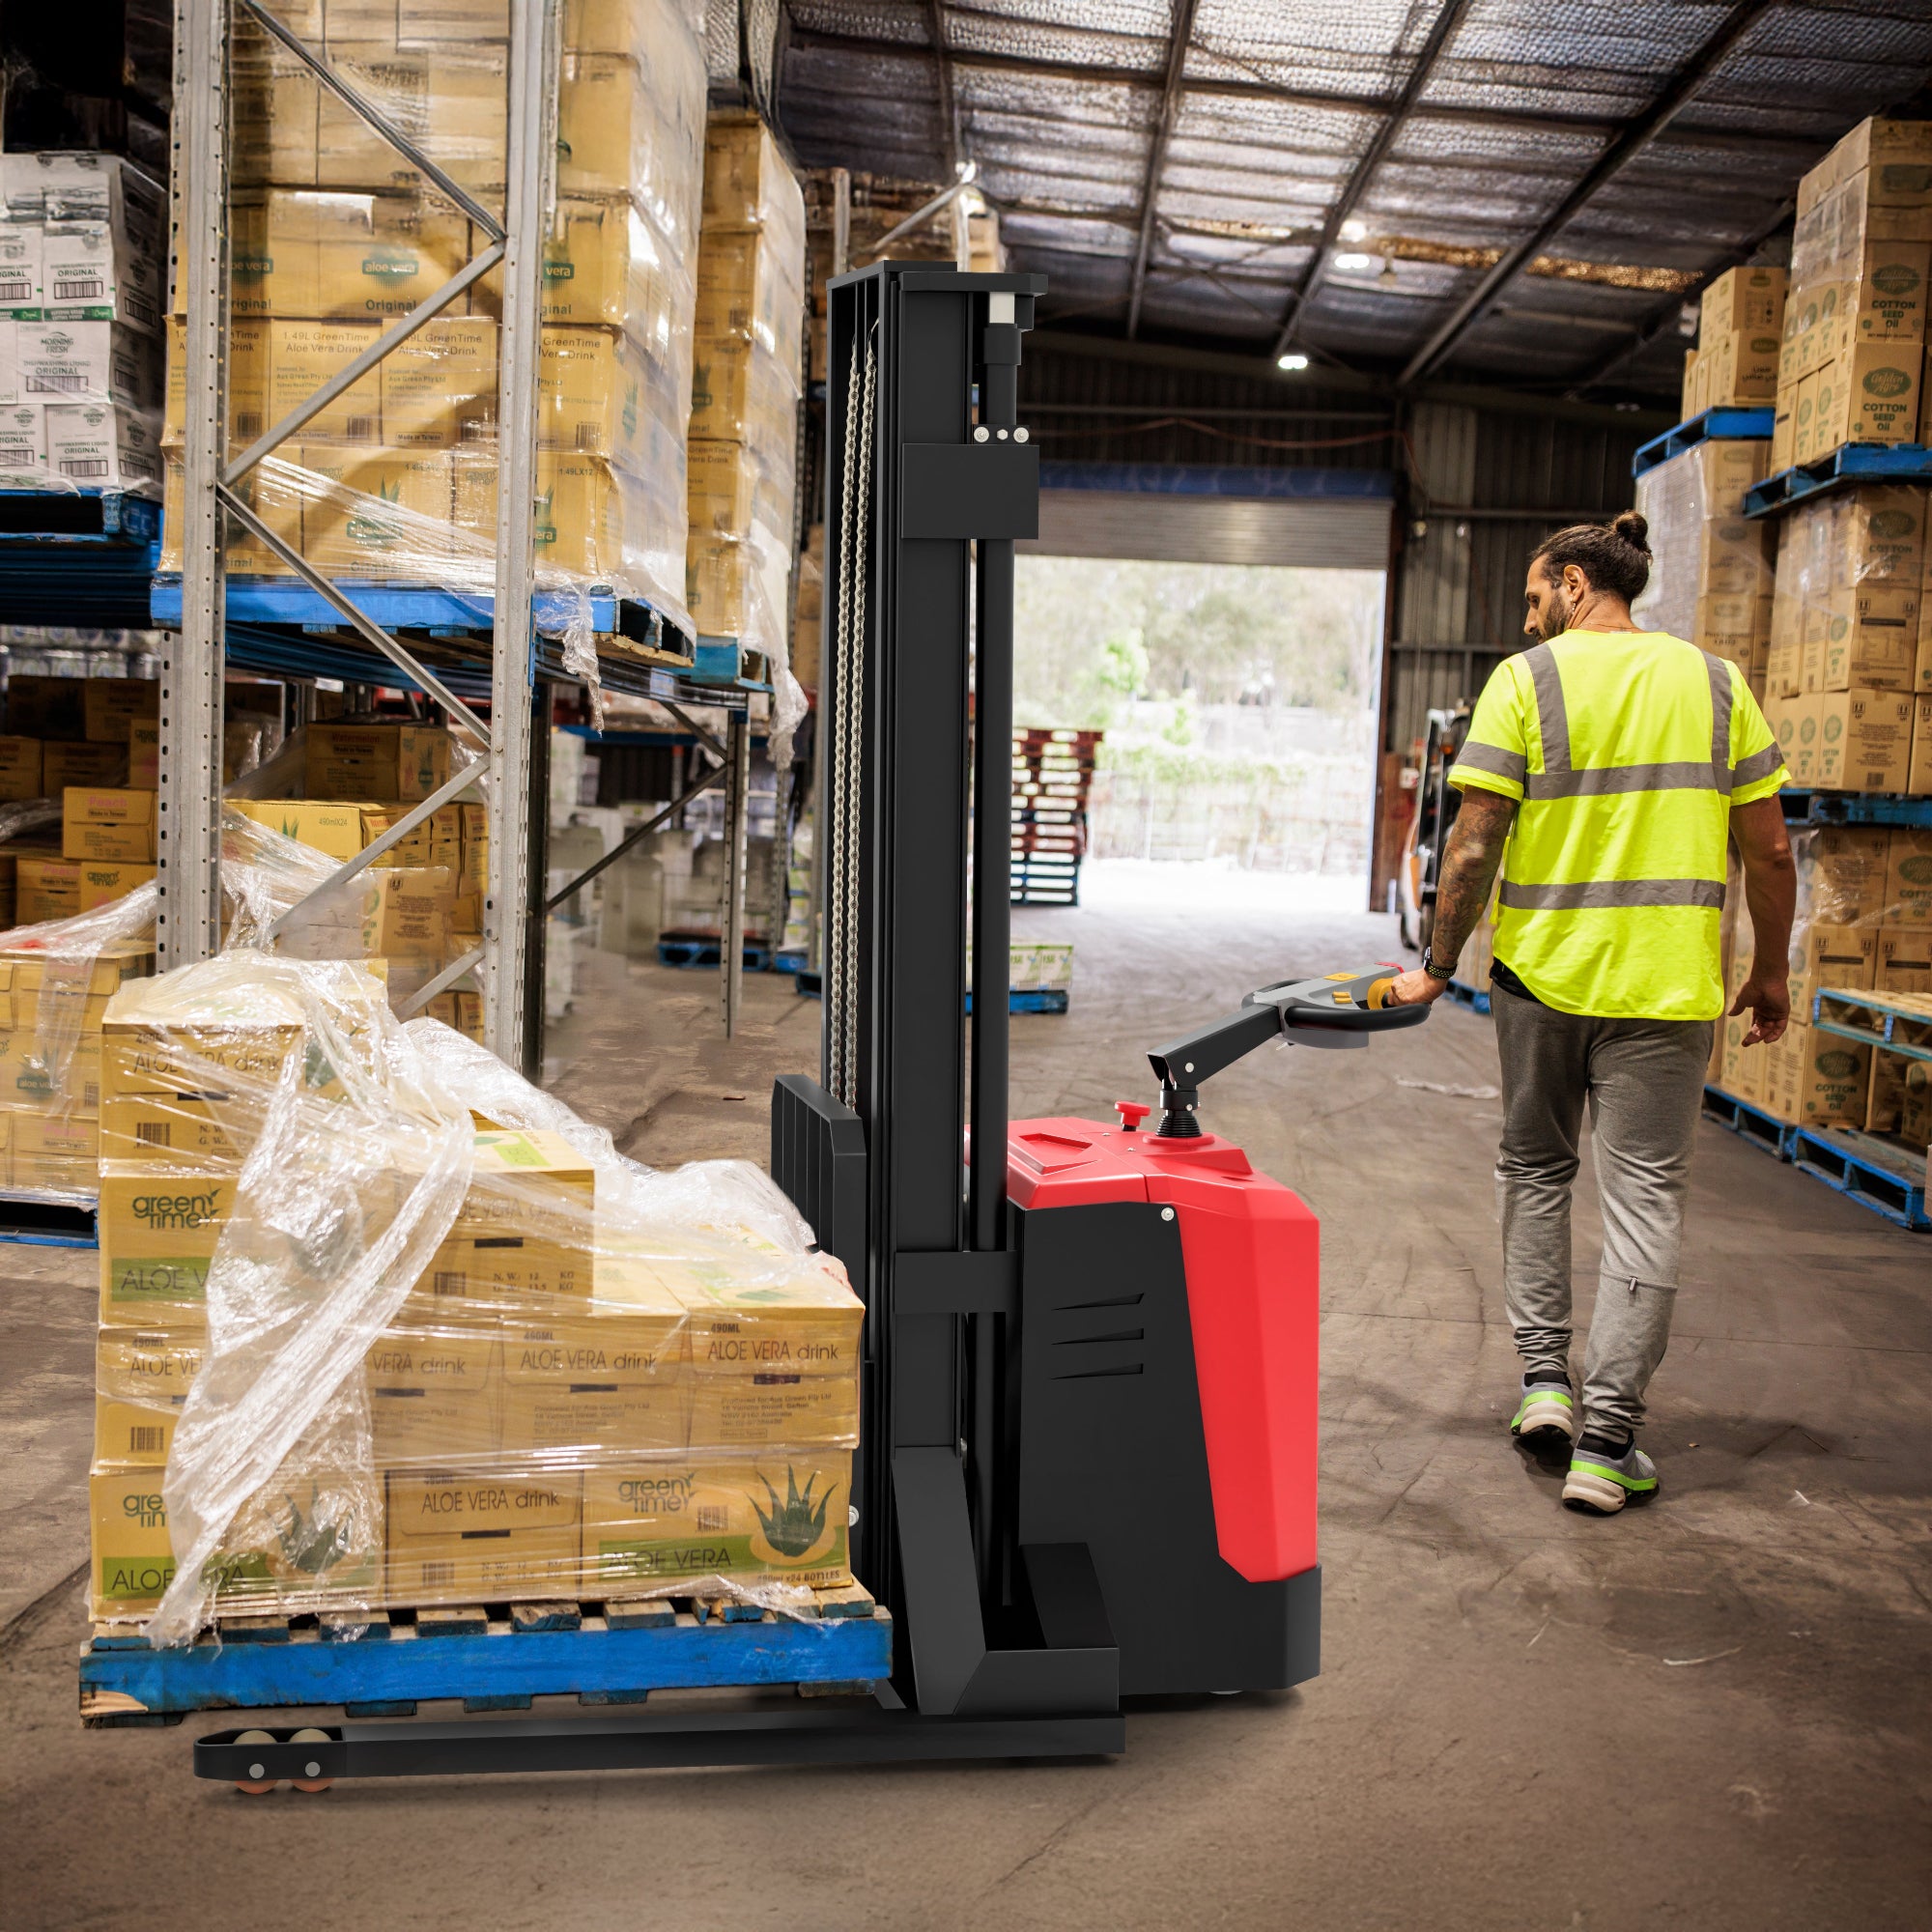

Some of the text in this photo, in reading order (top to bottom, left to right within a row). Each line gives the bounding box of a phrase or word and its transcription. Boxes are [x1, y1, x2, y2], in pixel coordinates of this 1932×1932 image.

[365, 262, 388, 272] aloe
[547, 267, 571, 276] vera
[58, 269, 98, 277] ORIGINAL
[365, 299, 416, 312] Original
[1871, 300, 1917, 309] COTTON
[1882, 310, 1904, 319] SEED
[543, 337, 601, 348] GreenTime
[286, 343, 364, 354] Aloe Vera Drink
[451, 346, 477, 355] Drink
[568, 350, 595, 360] Drink
[1862, 403, 1908, 412] COTTON
[1873, 412, 1895, 421] SEED
[1869, 544, 1912, 554] COTTON
[331, 733, 380, 743] Watermelon
[88, 796, 128, 808] Peach
[1816, 1083, 1857, 1094] COTTON
[132, 1196, 205, 1219] green
[121, 1268, 185, 1291] ALOE
[560, 1270, 575, 1280] KG
[559, 1282, 574, 1292] KG
[711, 1322, 741, 1333] 490ML
[524, 1330, 554, 1341] 490ML
[707, 1340, 838, 1361] ALOE VERA drink
[372, 1352, 467, 1374] VERA drink
[520, 1349, 658, 1370] ALOE VERA drink
[129, 1355, 173, 1377] ALOE
[618, 1479, 684, 1503] green
[123, 1494, 162, 1518] gre
[421, 1490, 560, 1515] ALOE VERA drink
[675, 1547, 732, 1570] VERA
[112, 1569, 175, 1591] ALOE
[786, 1573, 802, 1582] x24
[804, 1570, 840, 1582] BOTTLES
